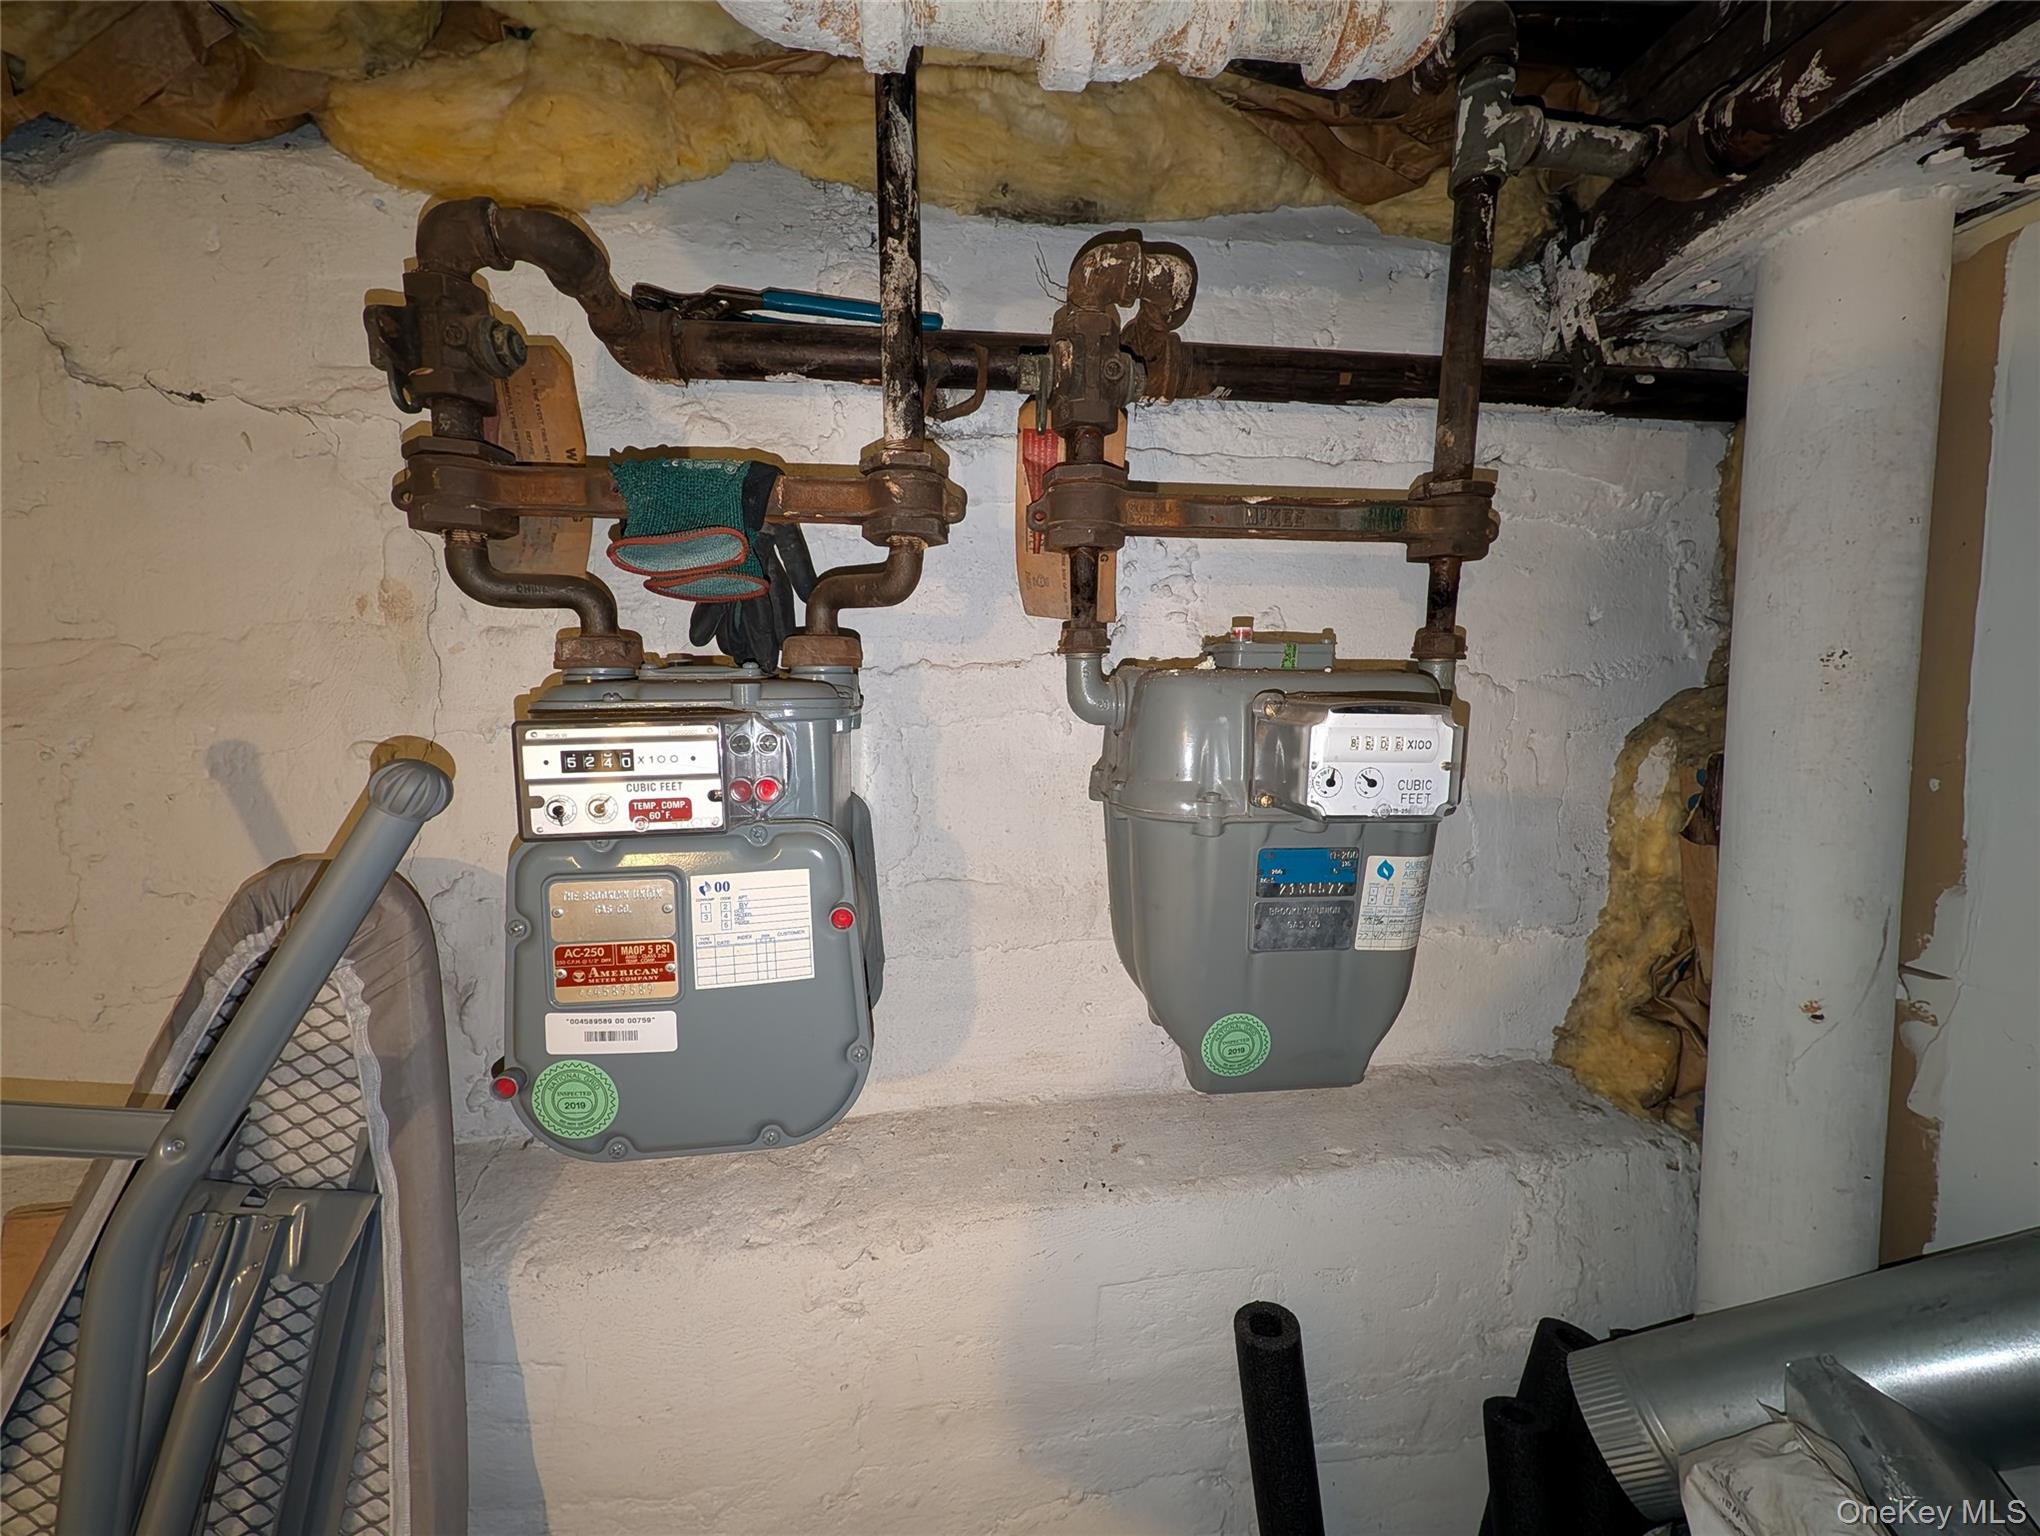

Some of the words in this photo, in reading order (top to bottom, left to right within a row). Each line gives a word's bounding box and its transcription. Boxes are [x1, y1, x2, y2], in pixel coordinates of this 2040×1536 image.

[626, 782, 657, 793] CUBIC
[660, 781, 683, 791] FEET
[1397, 779, 1433, 791] CUBIC
[1400, 792, 1432, 804] FEET
[633, 801, 660, 810] TEMP.
[661, 800, 689, 810] COMP.
[714, 881, 731, 893] 00
[563, 890, 579, 902] THE
[594, 904, 614, 914] GAS
[564, 947, 605, 958] AC-250
[620, 945, 645, 956] MAOP
[648, 945, 653, 953] 5
[655, 943, 670, 954] PSI
[620, 975, 659, 983] COMPANY
[1227, 1047, 1245, 1056] 2019
[548, 1072, 581, 1092] NATIONAL
[564, 1101, 586, 1110] 2019
